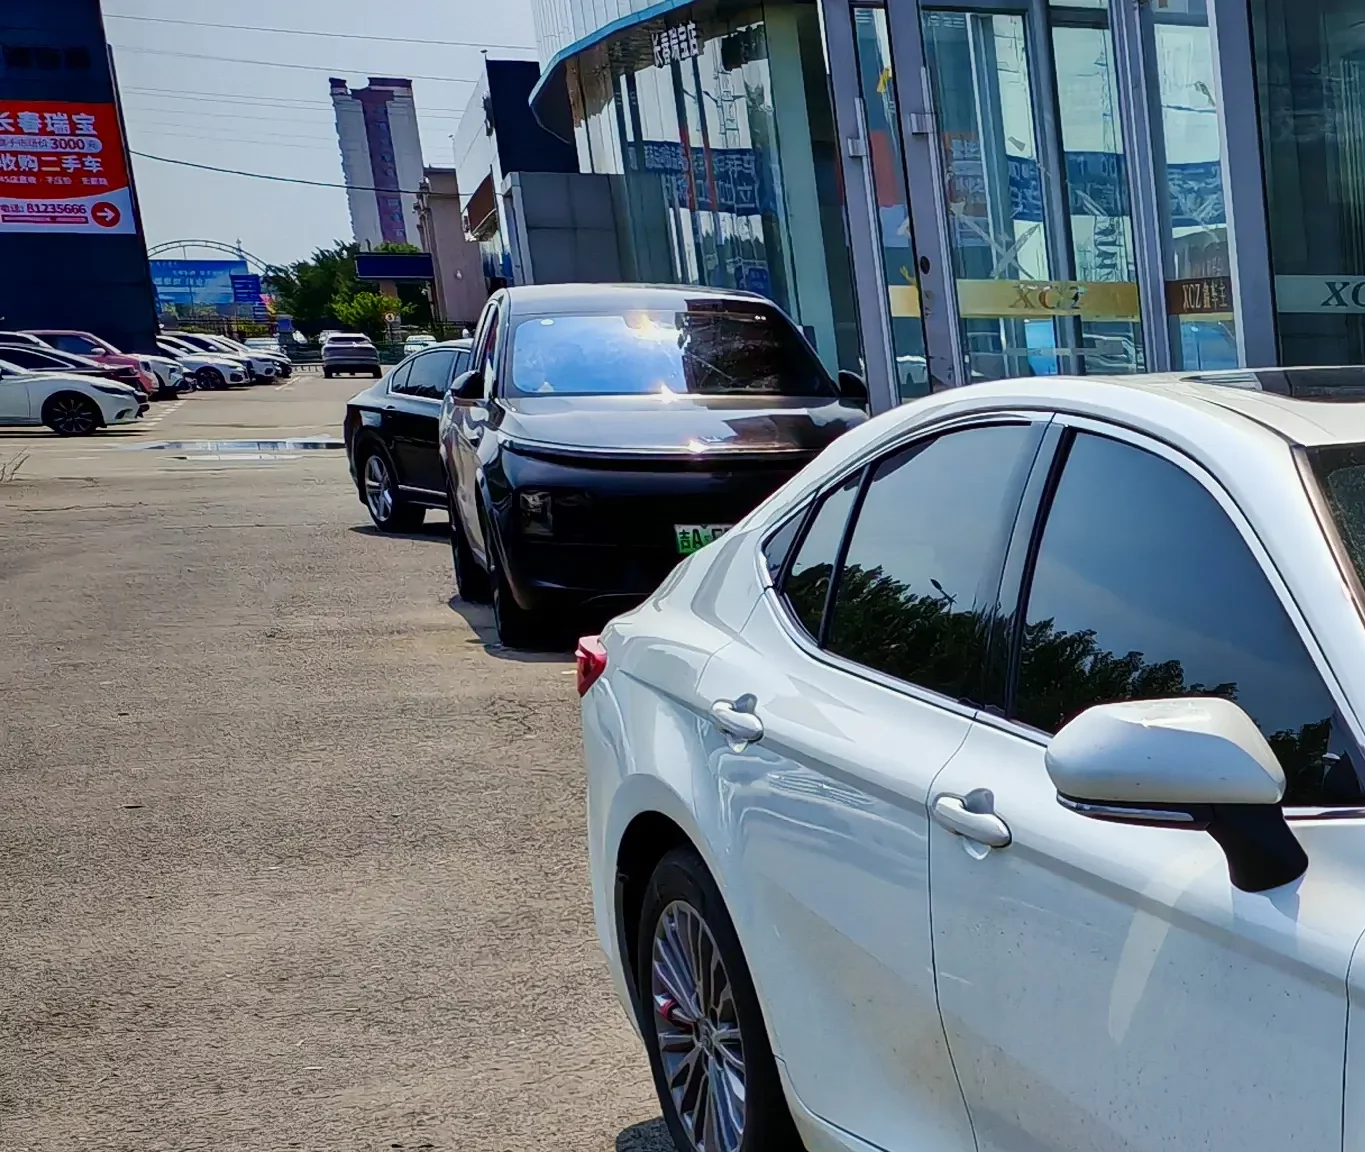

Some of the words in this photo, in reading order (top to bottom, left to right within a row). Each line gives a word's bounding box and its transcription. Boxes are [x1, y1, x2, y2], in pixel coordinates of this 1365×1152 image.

[652, 20, 699, 67] 长春瑞宝店
[1182, 283, 1202, 310] XCZ
